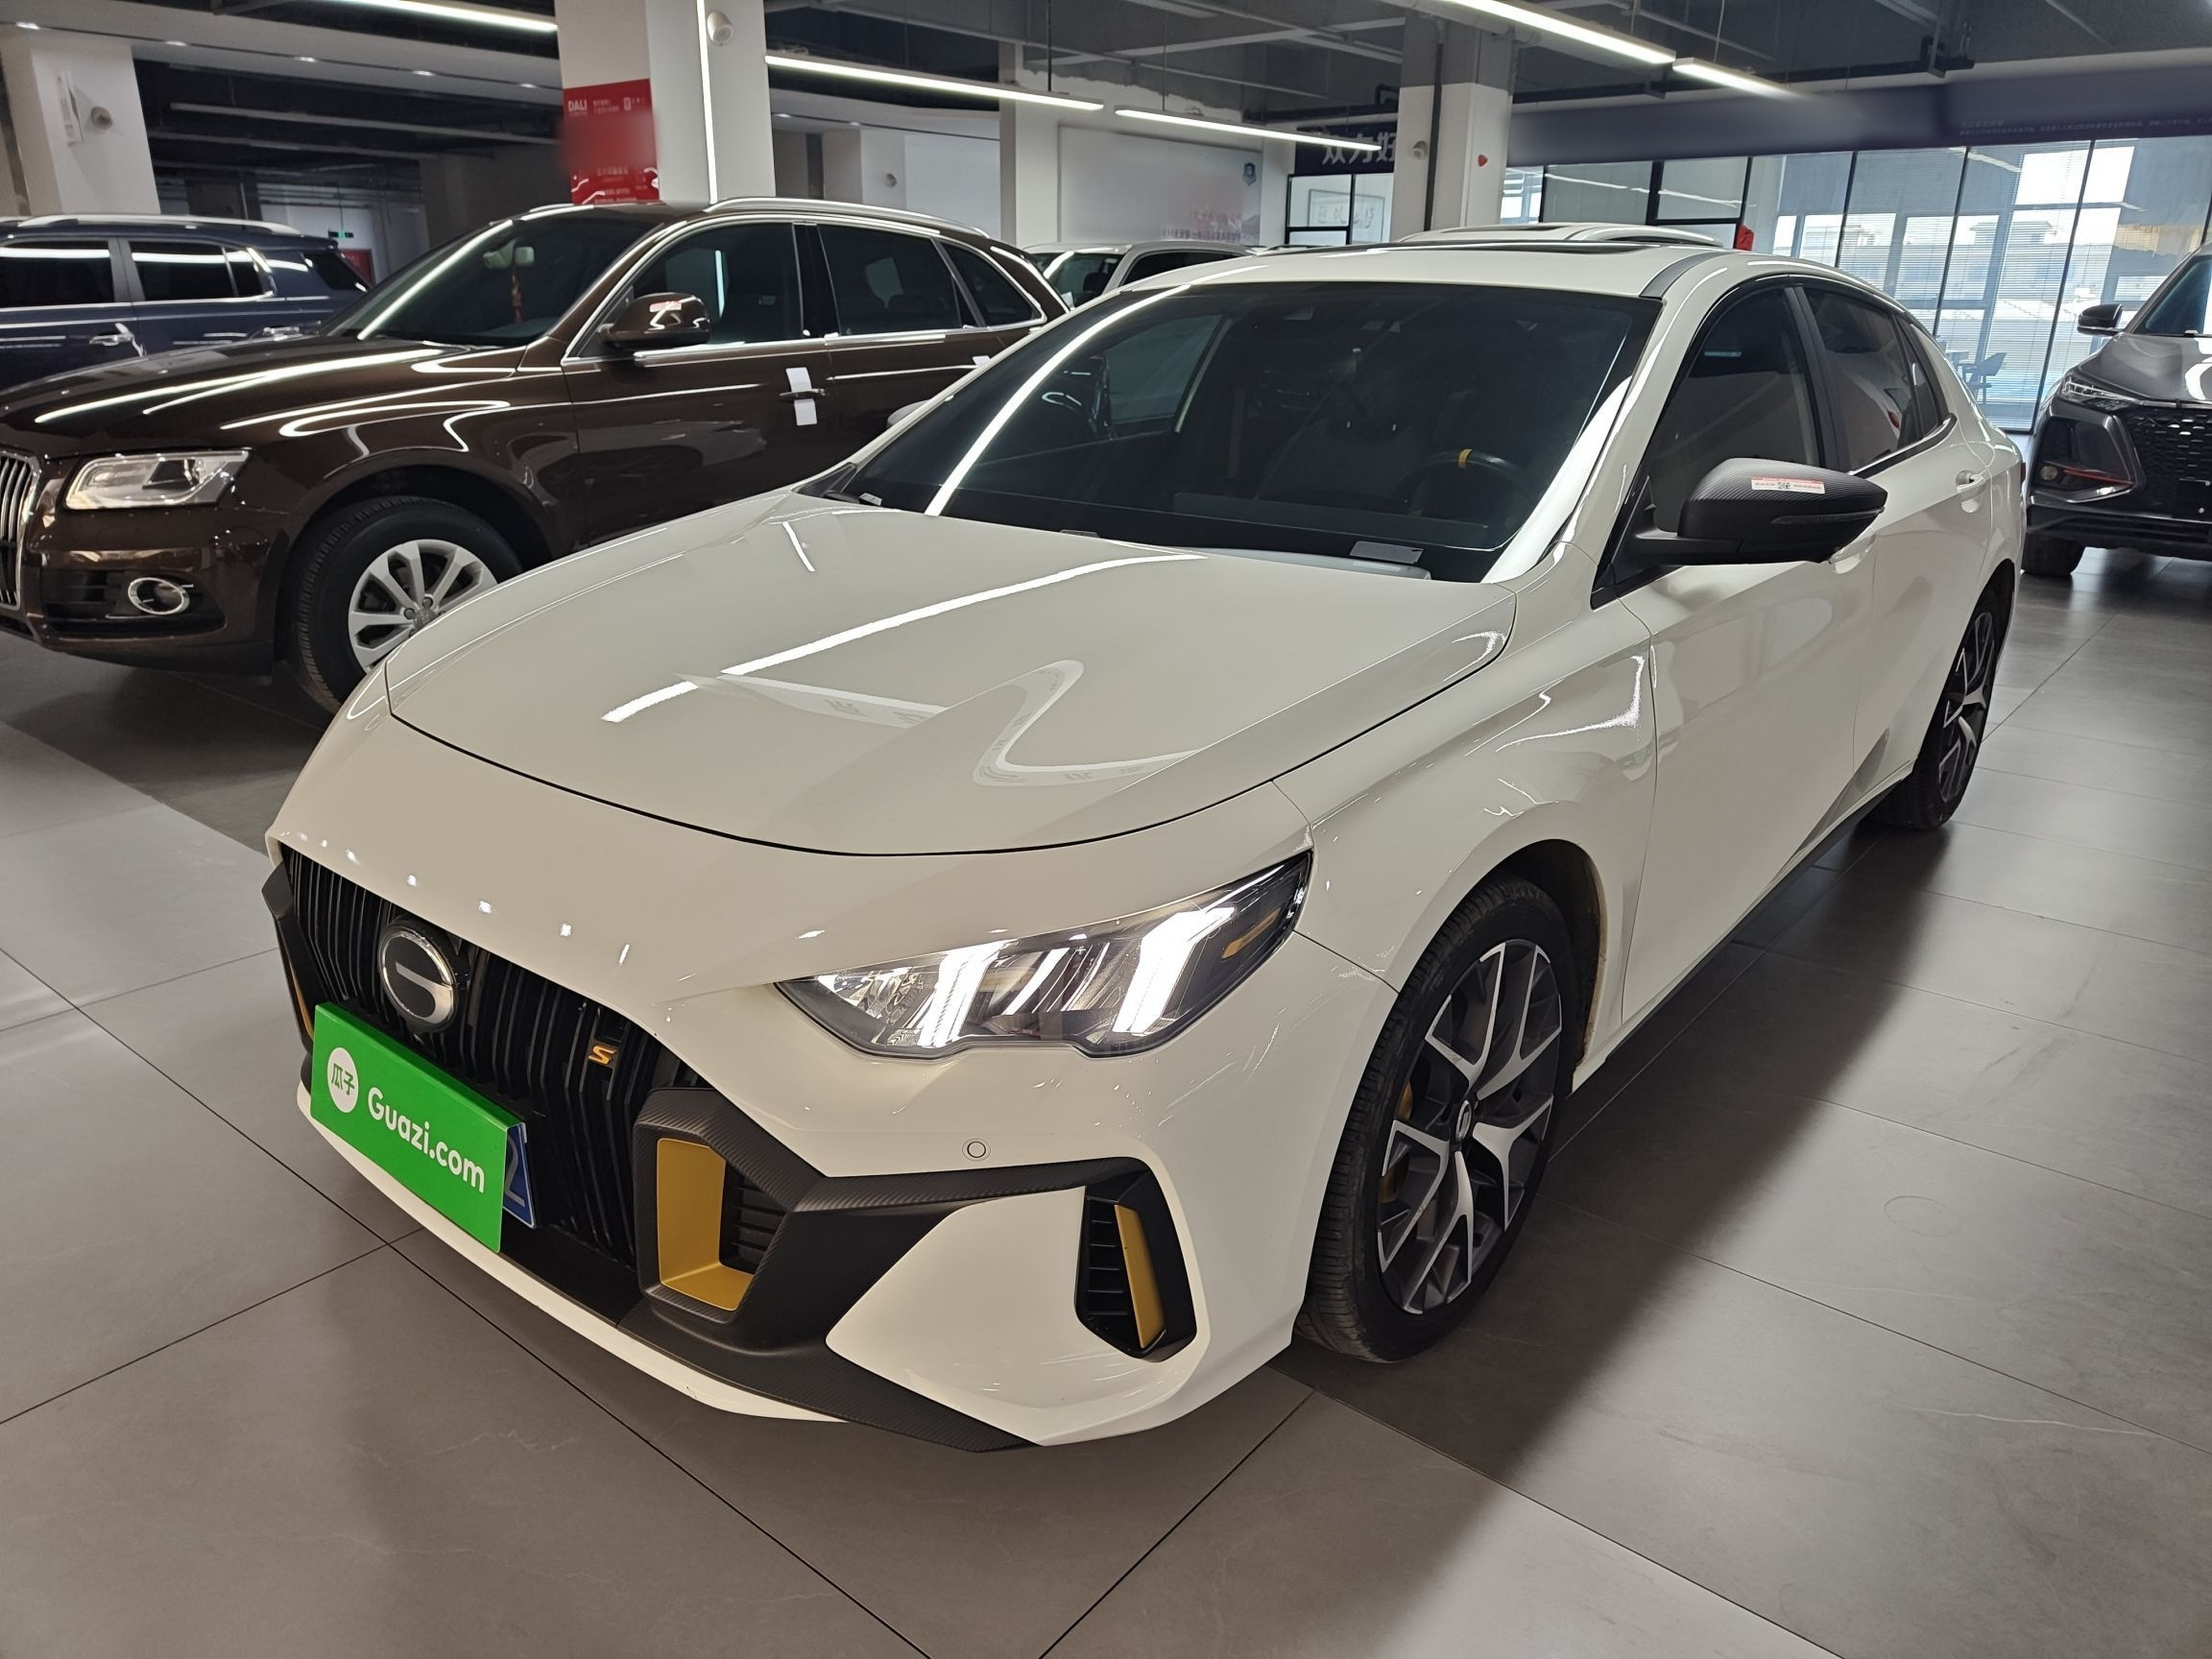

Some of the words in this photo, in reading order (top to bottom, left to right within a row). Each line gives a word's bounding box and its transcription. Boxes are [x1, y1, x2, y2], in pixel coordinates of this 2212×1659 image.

[588, 1045, 616, 1065] S
[331, 1063, 355, 1096] 瓜子
[367, 1086, 485, 1194] Guazi.com
